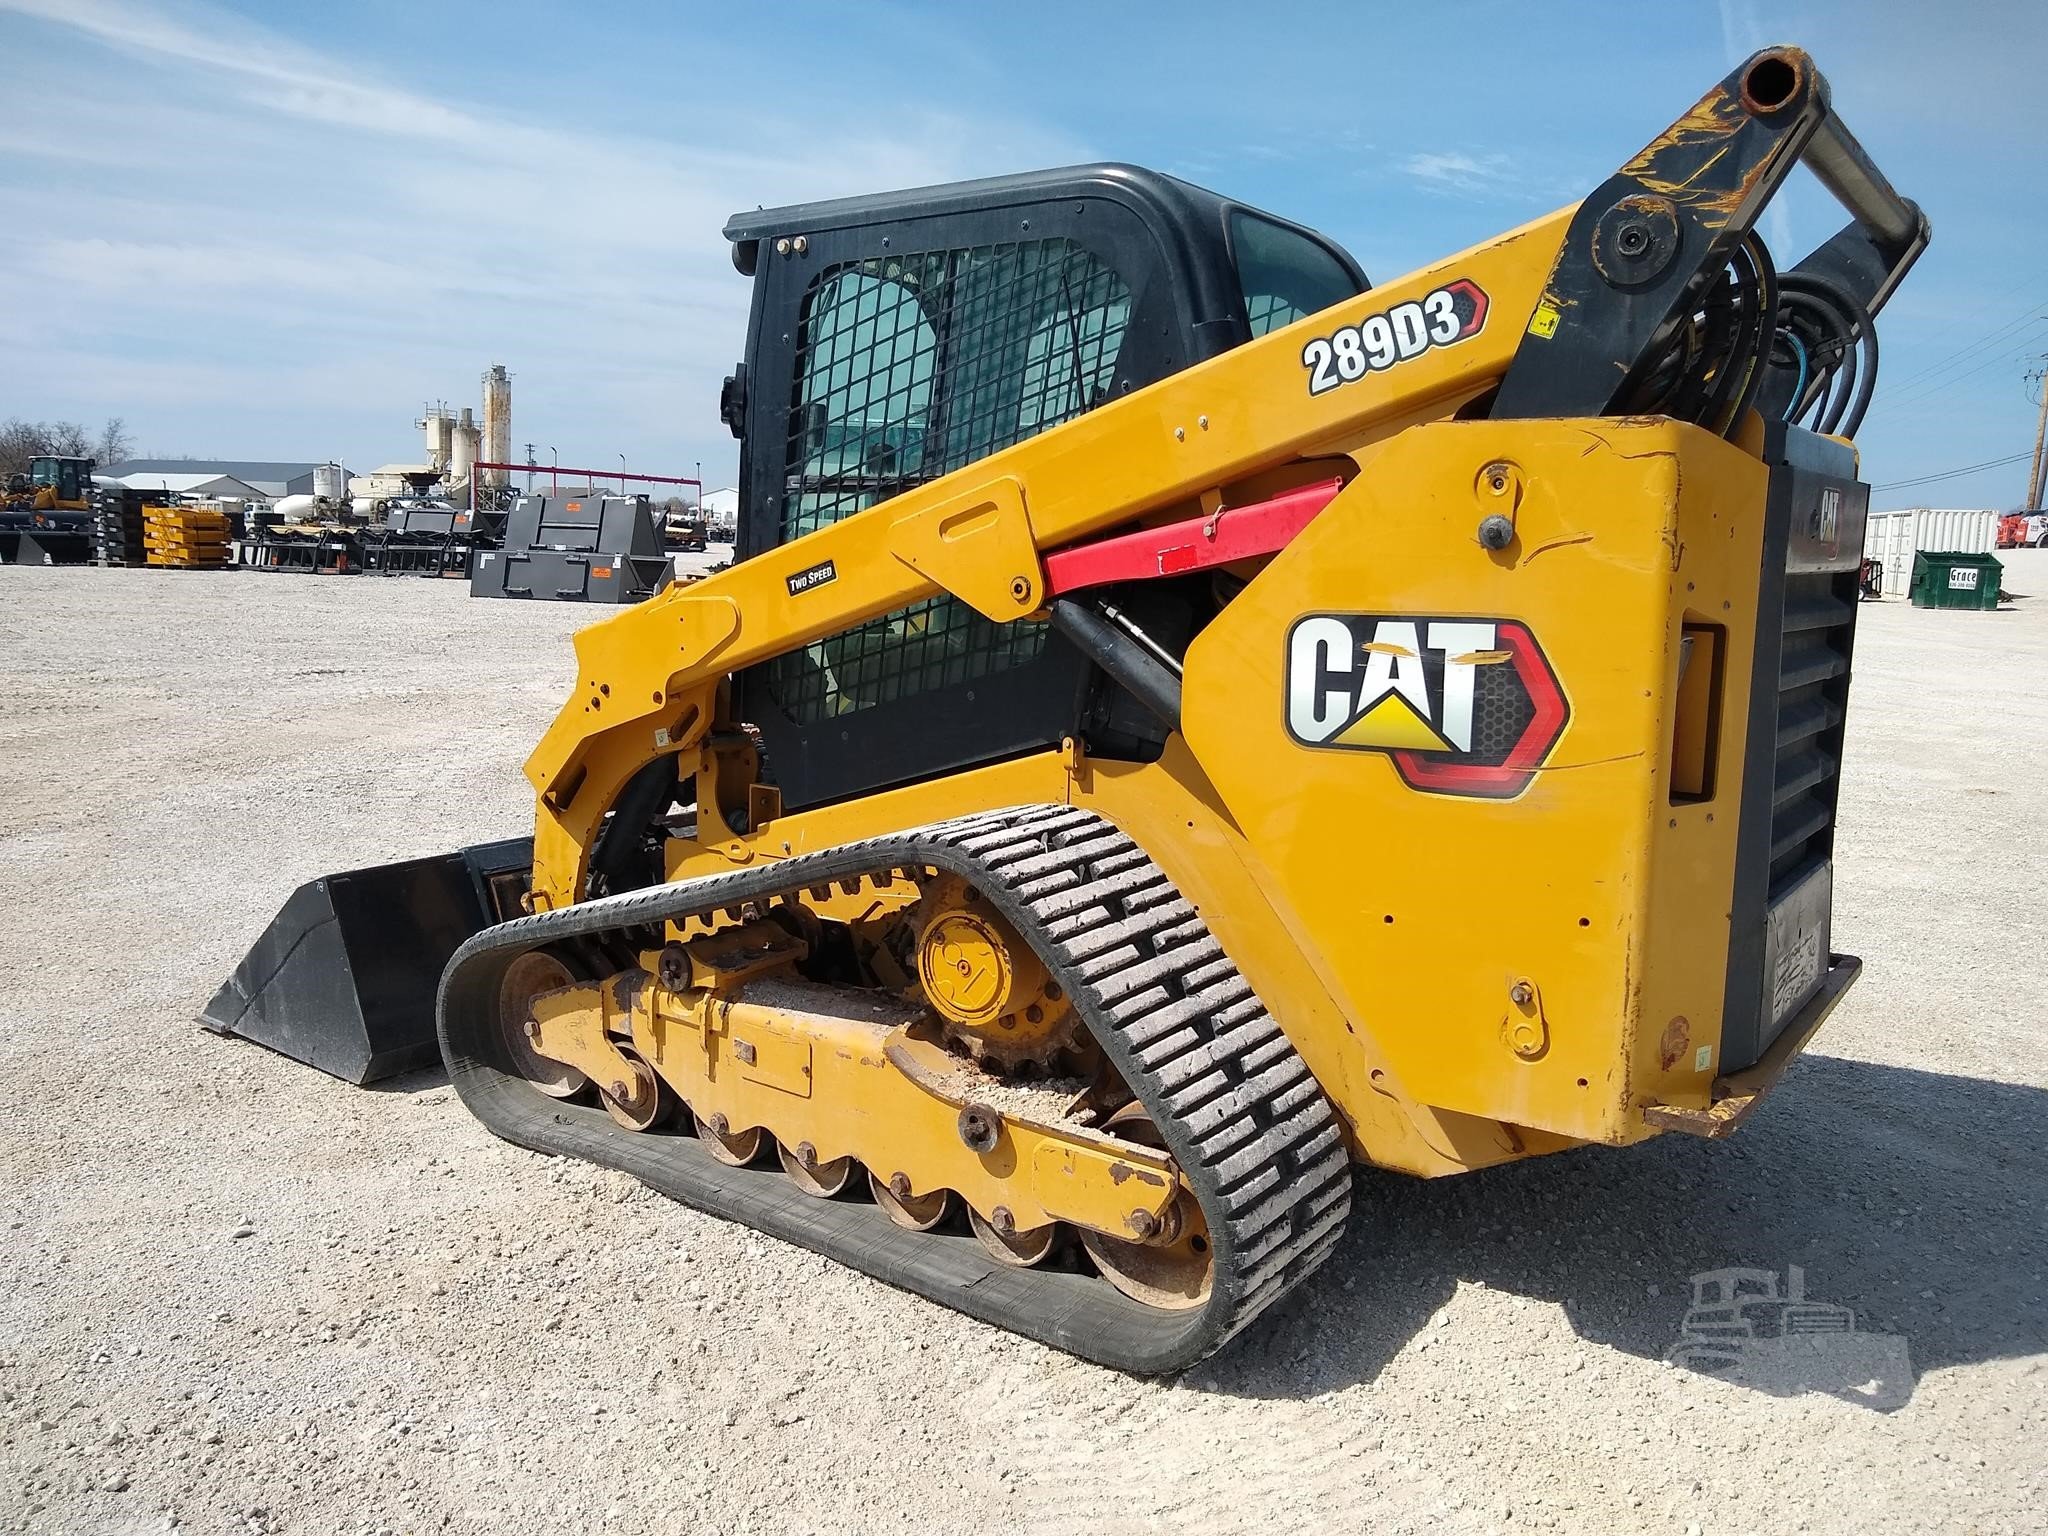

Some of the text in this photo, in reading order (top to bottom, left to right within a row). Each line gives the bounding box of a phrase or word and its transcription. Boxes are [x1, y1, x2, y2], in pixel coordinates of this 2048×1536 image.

[1304, 290, 1461, 394] 289D3
[1820, 490, 1839, 541] CAT
[1951, 569, 1976, 582] Grace
[1290, 617, 1497, 753] CAT
